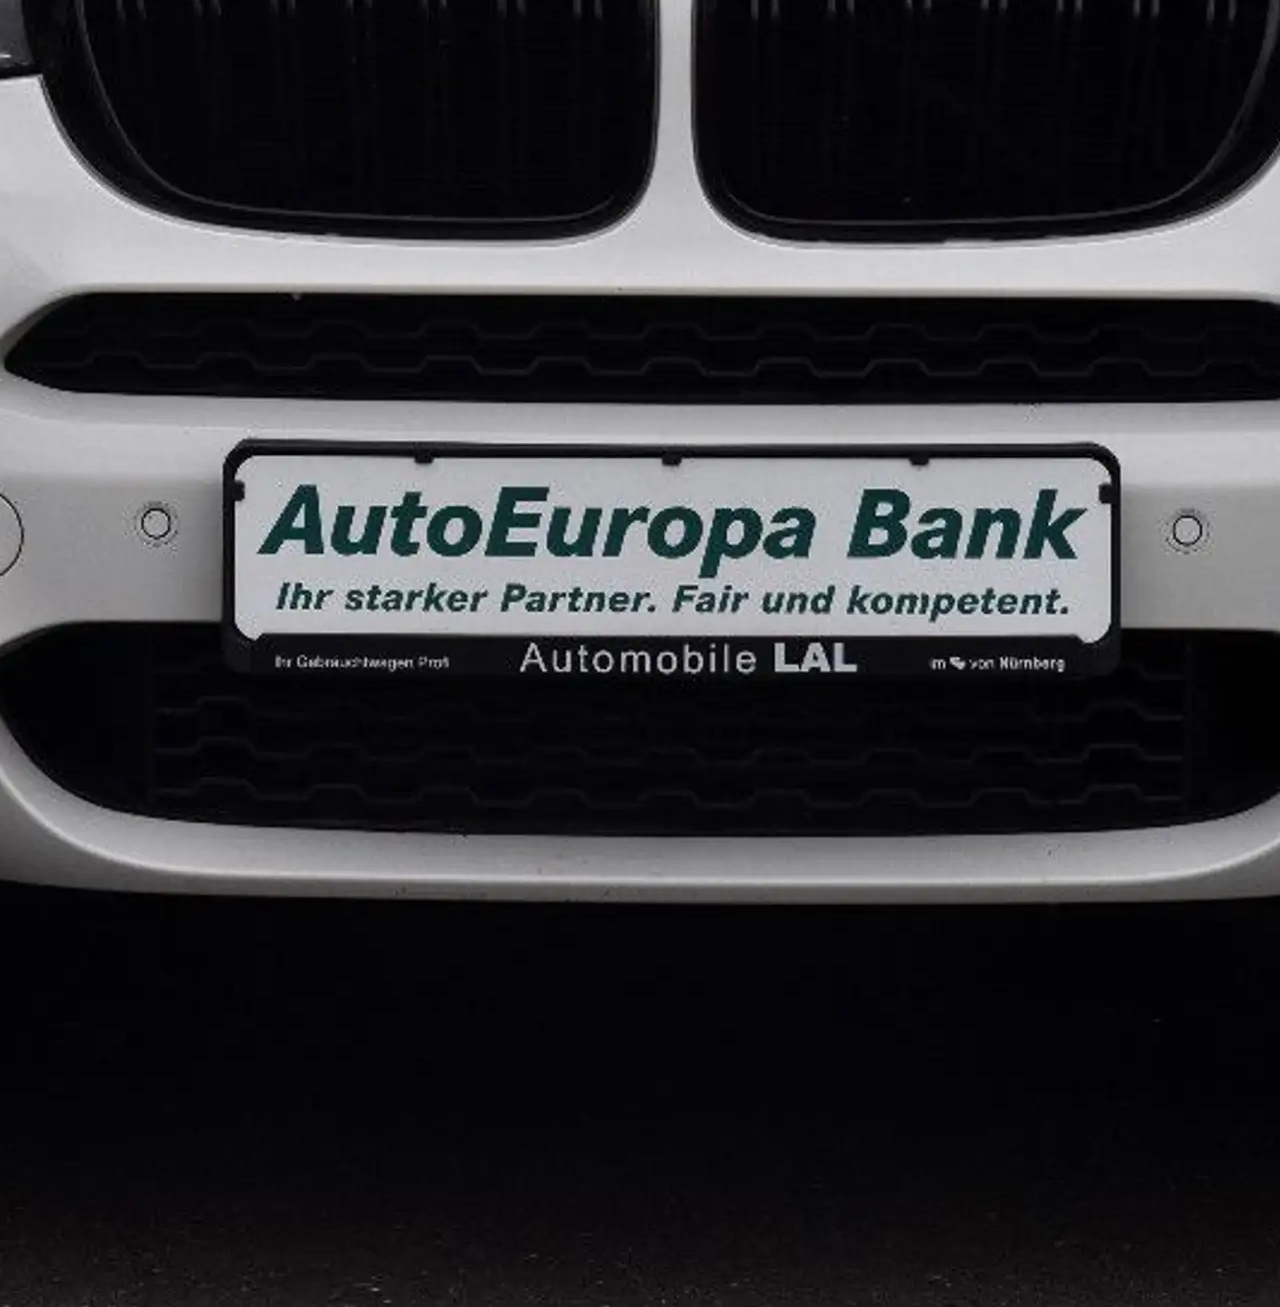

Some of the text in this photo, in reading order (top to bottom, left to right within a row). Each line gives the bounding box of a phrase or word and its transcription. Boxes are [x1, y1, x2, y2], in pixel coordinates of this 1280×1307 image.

[257, 484, 1087, 579] AutoEuropa Bank
[275, 582, 1069, 622] Ihr starker Partner. Fair und kompetent.
[519, 641, 858, 674] Automobile LAL
